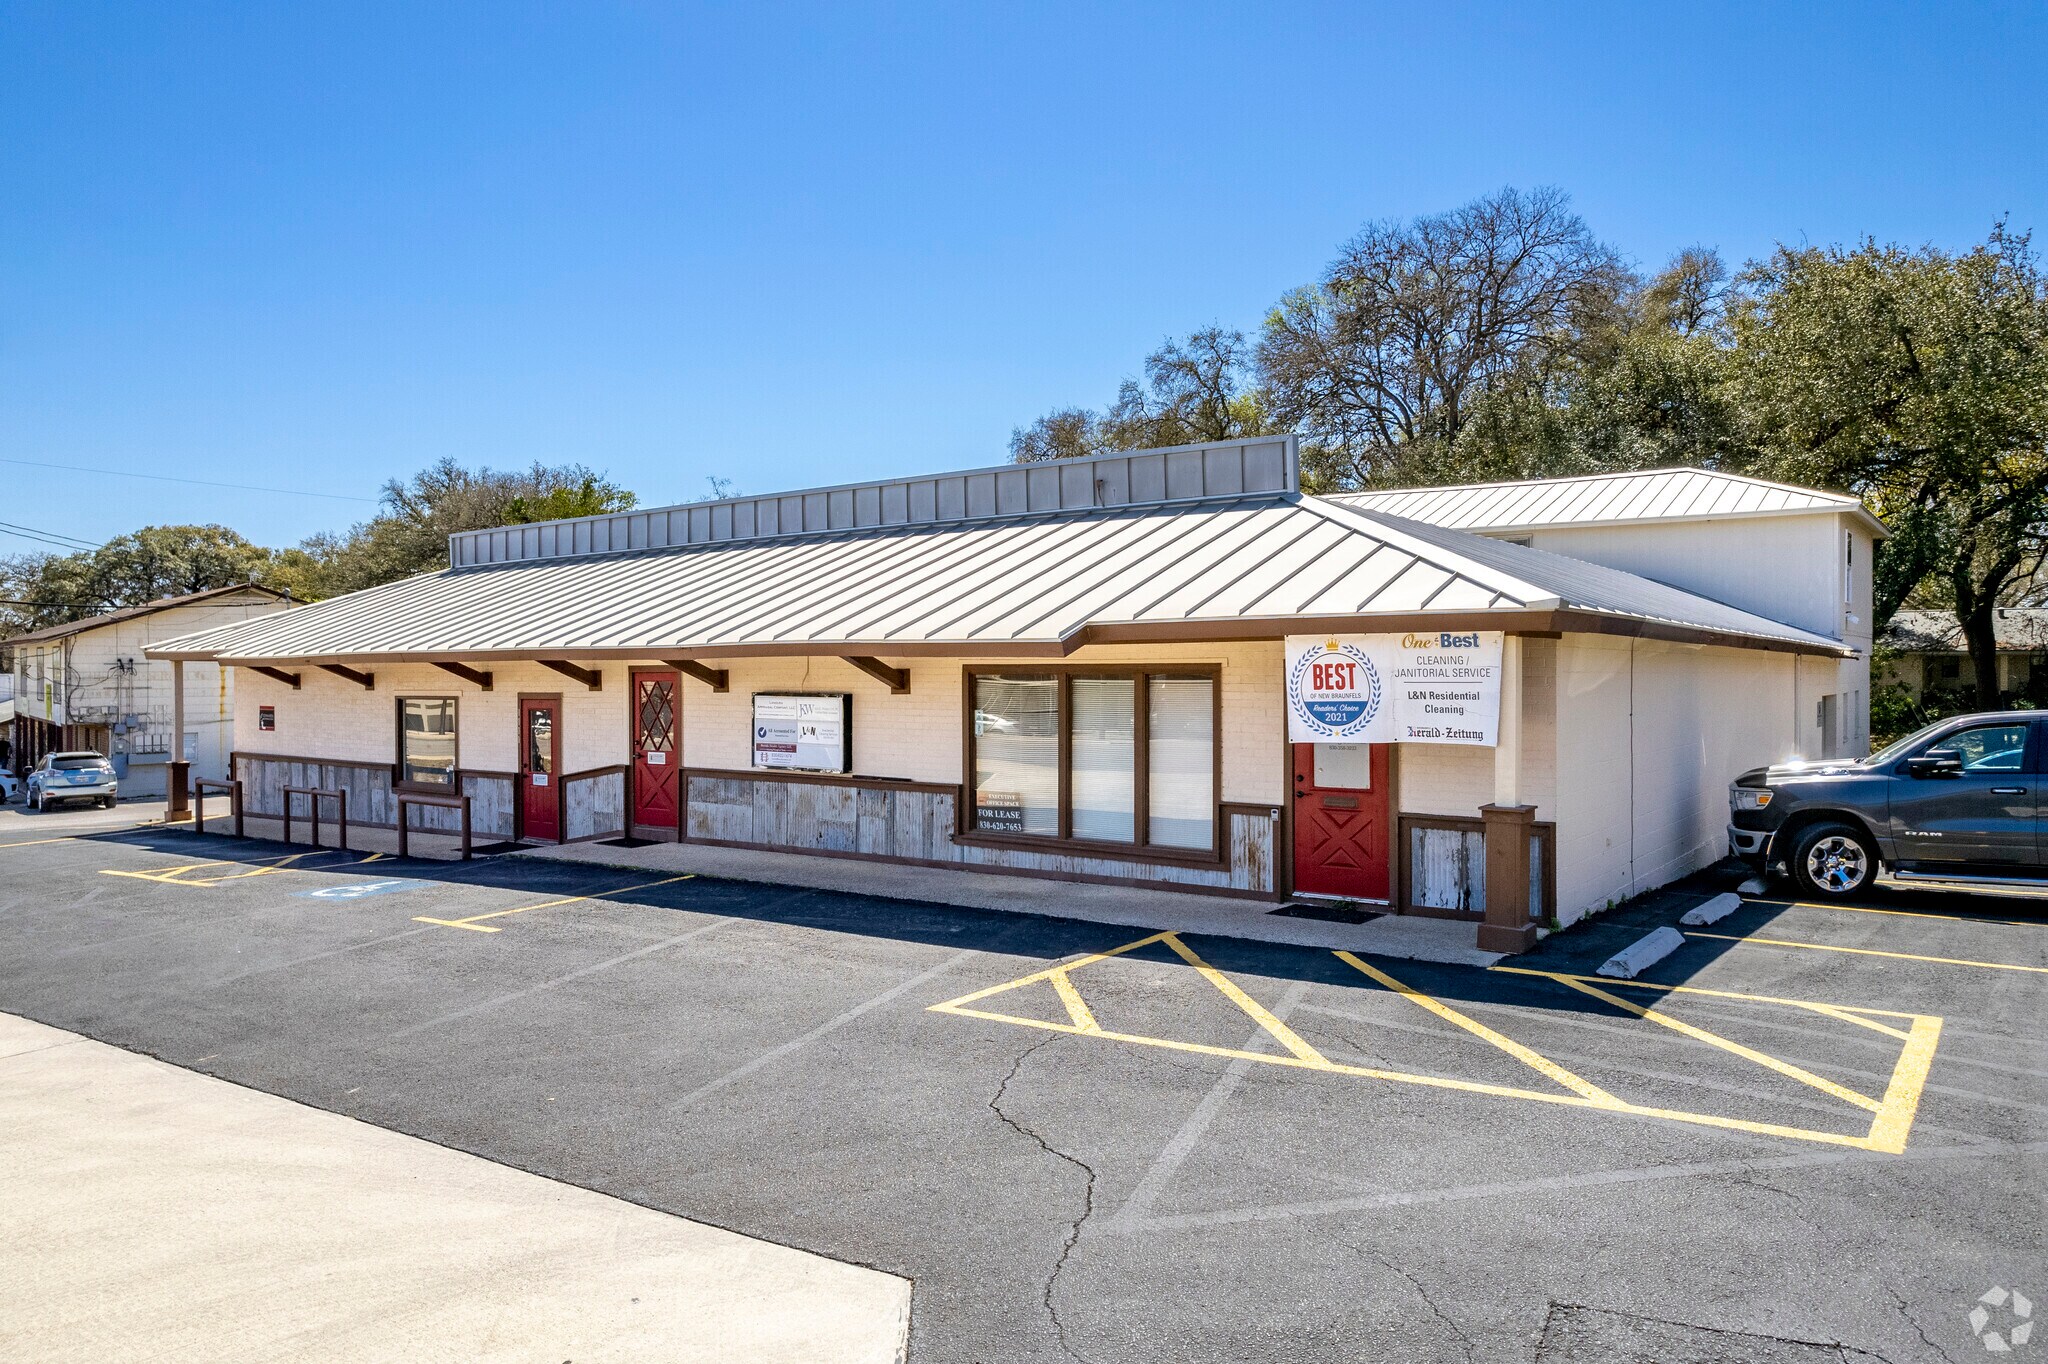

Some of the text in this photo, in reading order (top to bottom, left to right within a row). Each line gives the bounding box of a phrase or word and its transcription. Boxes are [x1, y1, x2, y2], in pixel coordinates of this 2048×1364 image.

[1402, 633, 1432, 649] One
[1440, 633, 1479, 648] Best
[1416, 655, 1464, 665] CLEANING
[1312, 663, 1356, 691] BEST
[1394, 668, 1491, 678] JANITORIAL SERVICE
[1407, 691, 1480, 701] L&N Residential
[1339, 704, 1360, 712] Choice
[1424, 704, 1464, 716] Cleaning
[1325, 712, 1347, 722] 2021
[978, 808, 1021, 819] FOR LEASE
[979, 820, 1022, 832] 830-620-7653
